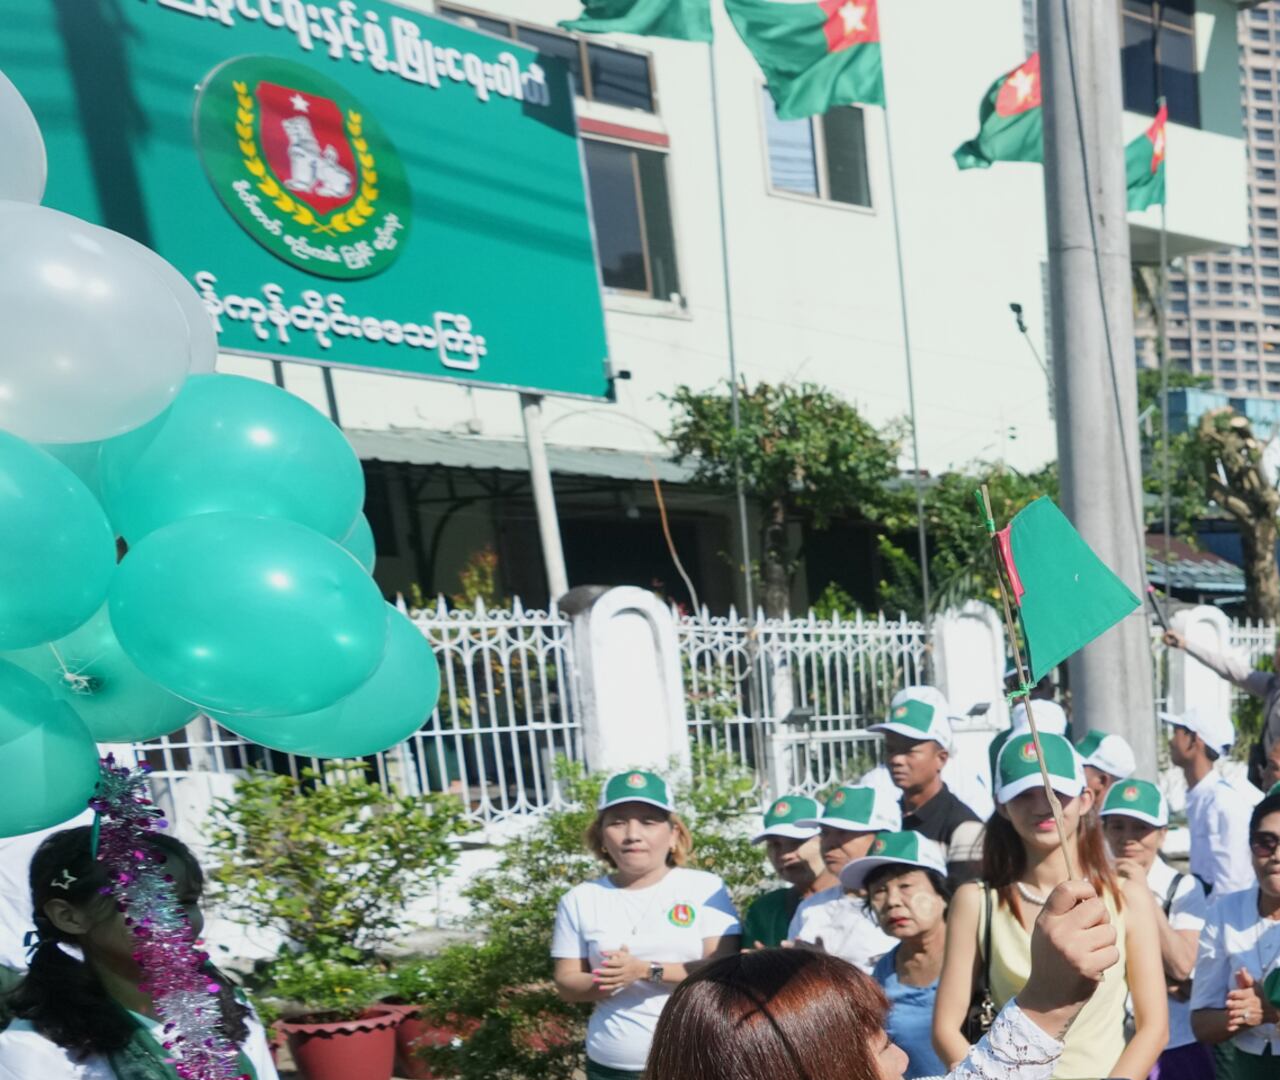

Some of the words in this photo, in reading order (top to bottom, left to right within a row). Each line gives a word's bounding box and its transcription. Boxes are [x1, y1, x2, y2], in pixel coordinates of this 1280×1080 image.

[195, 270, 488, 371] န်ကုန်တိုင်းဒေသကြီး
